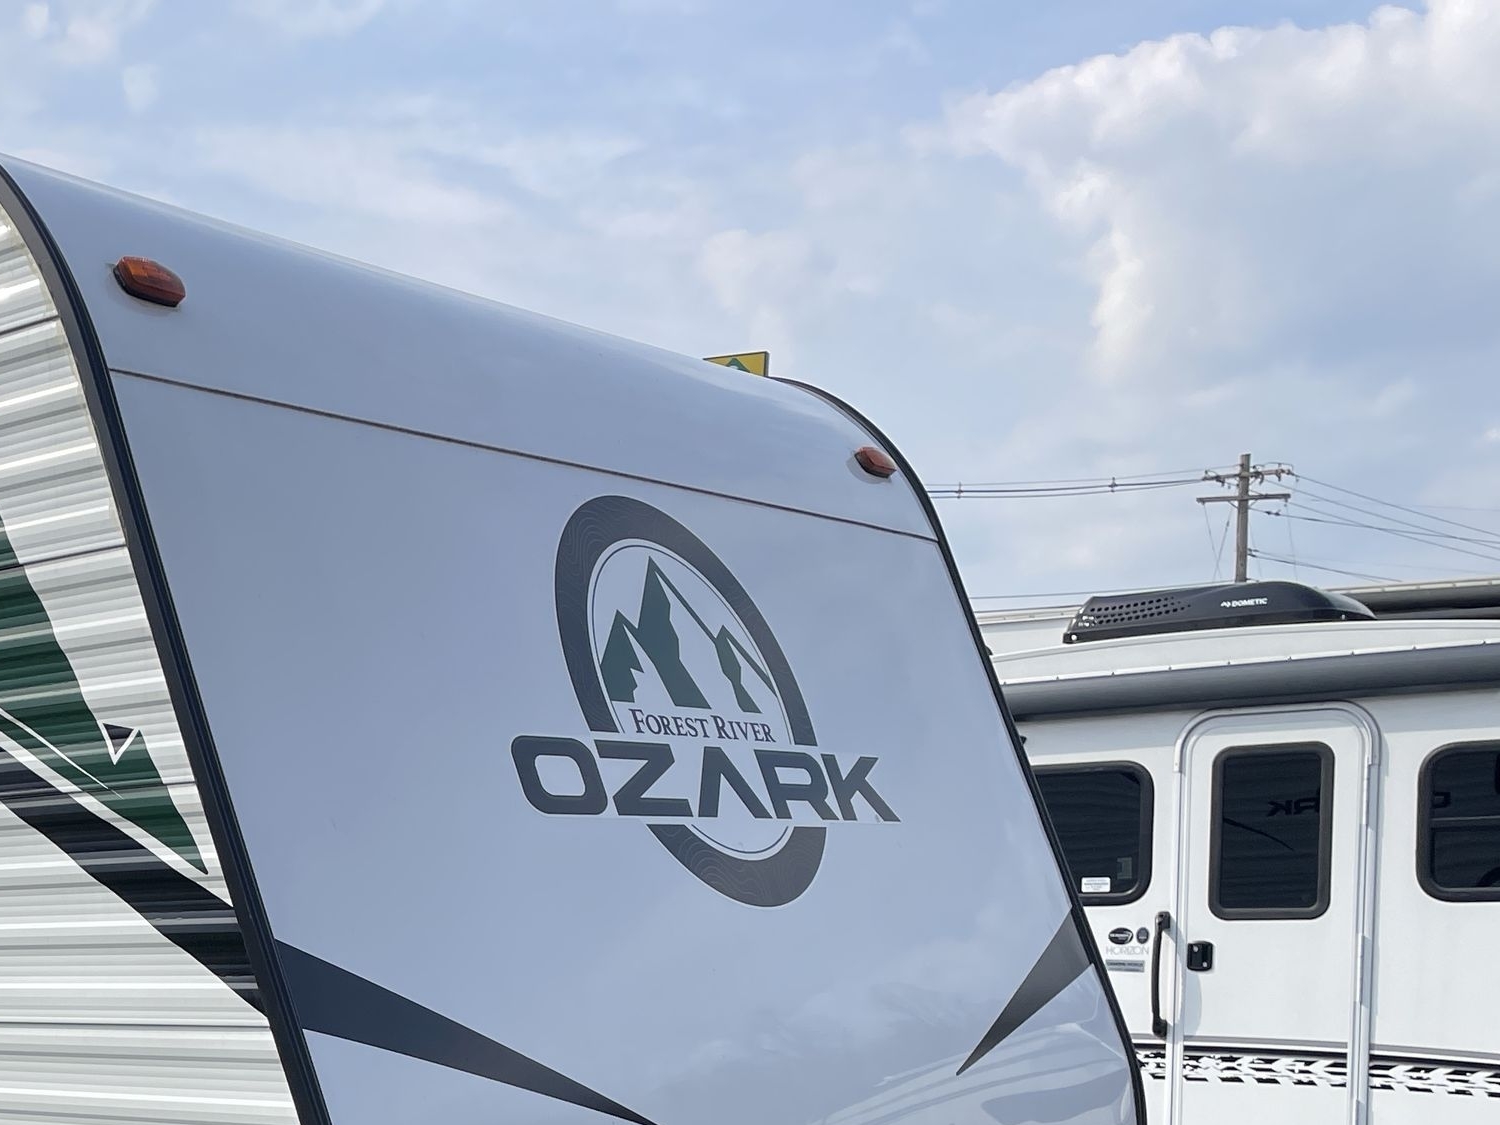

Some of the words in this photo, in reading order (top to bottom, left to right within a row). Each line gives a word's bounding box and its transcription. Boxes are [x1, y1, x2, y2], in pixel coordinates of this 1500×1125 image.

[628, 708, 710, 738] FOREST
[710, 714, 777, 743] RIVER
[511, 735, 901, 822] OZARK
